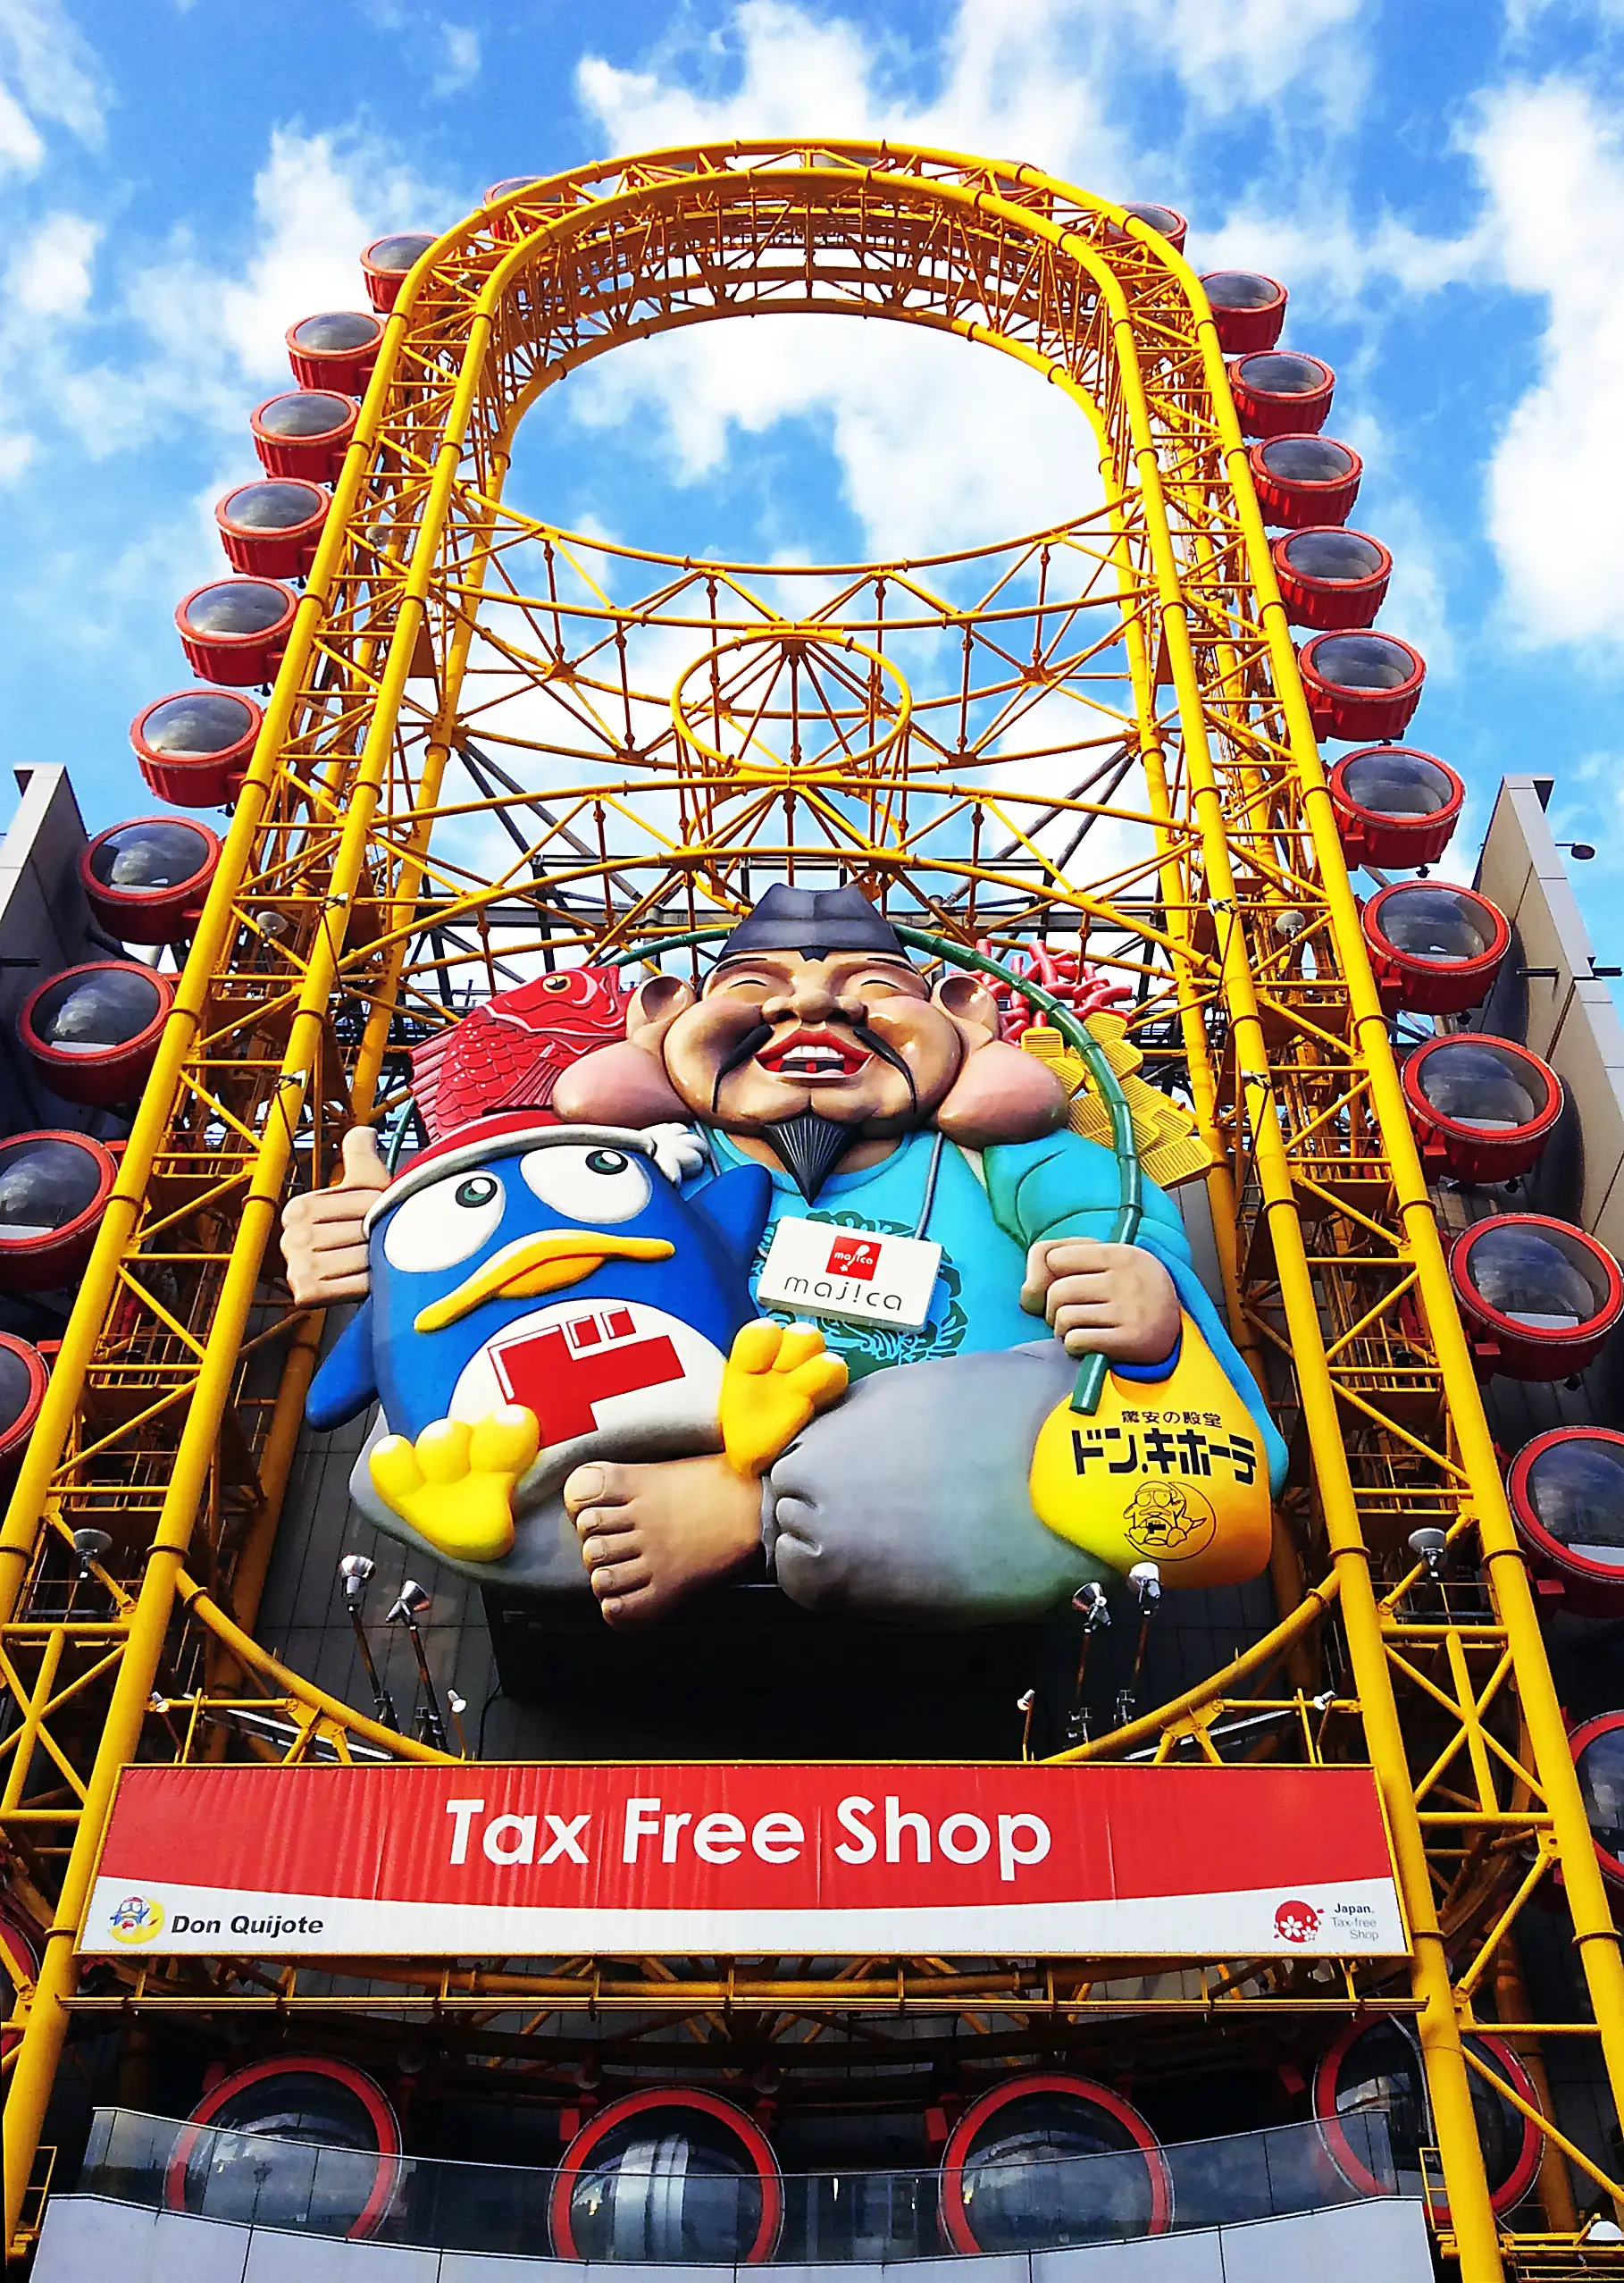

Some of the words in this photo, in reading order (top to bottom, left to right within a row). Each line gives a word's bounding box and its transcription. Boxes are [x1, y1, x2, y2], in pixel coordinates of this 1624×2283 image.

[1121, 1410, 1223, 1429] 驚安の殿堂
[446, 1799, 591, 1865] Tax
[623, 1798, 805, 1865] Free
[834, 1795, 1051, 1881] Shop
[171, 1915, 222, 1934] Don
[230, 1915, 324, 1939] Quijote
[1350, 1930, 1379, 1942] Shop
